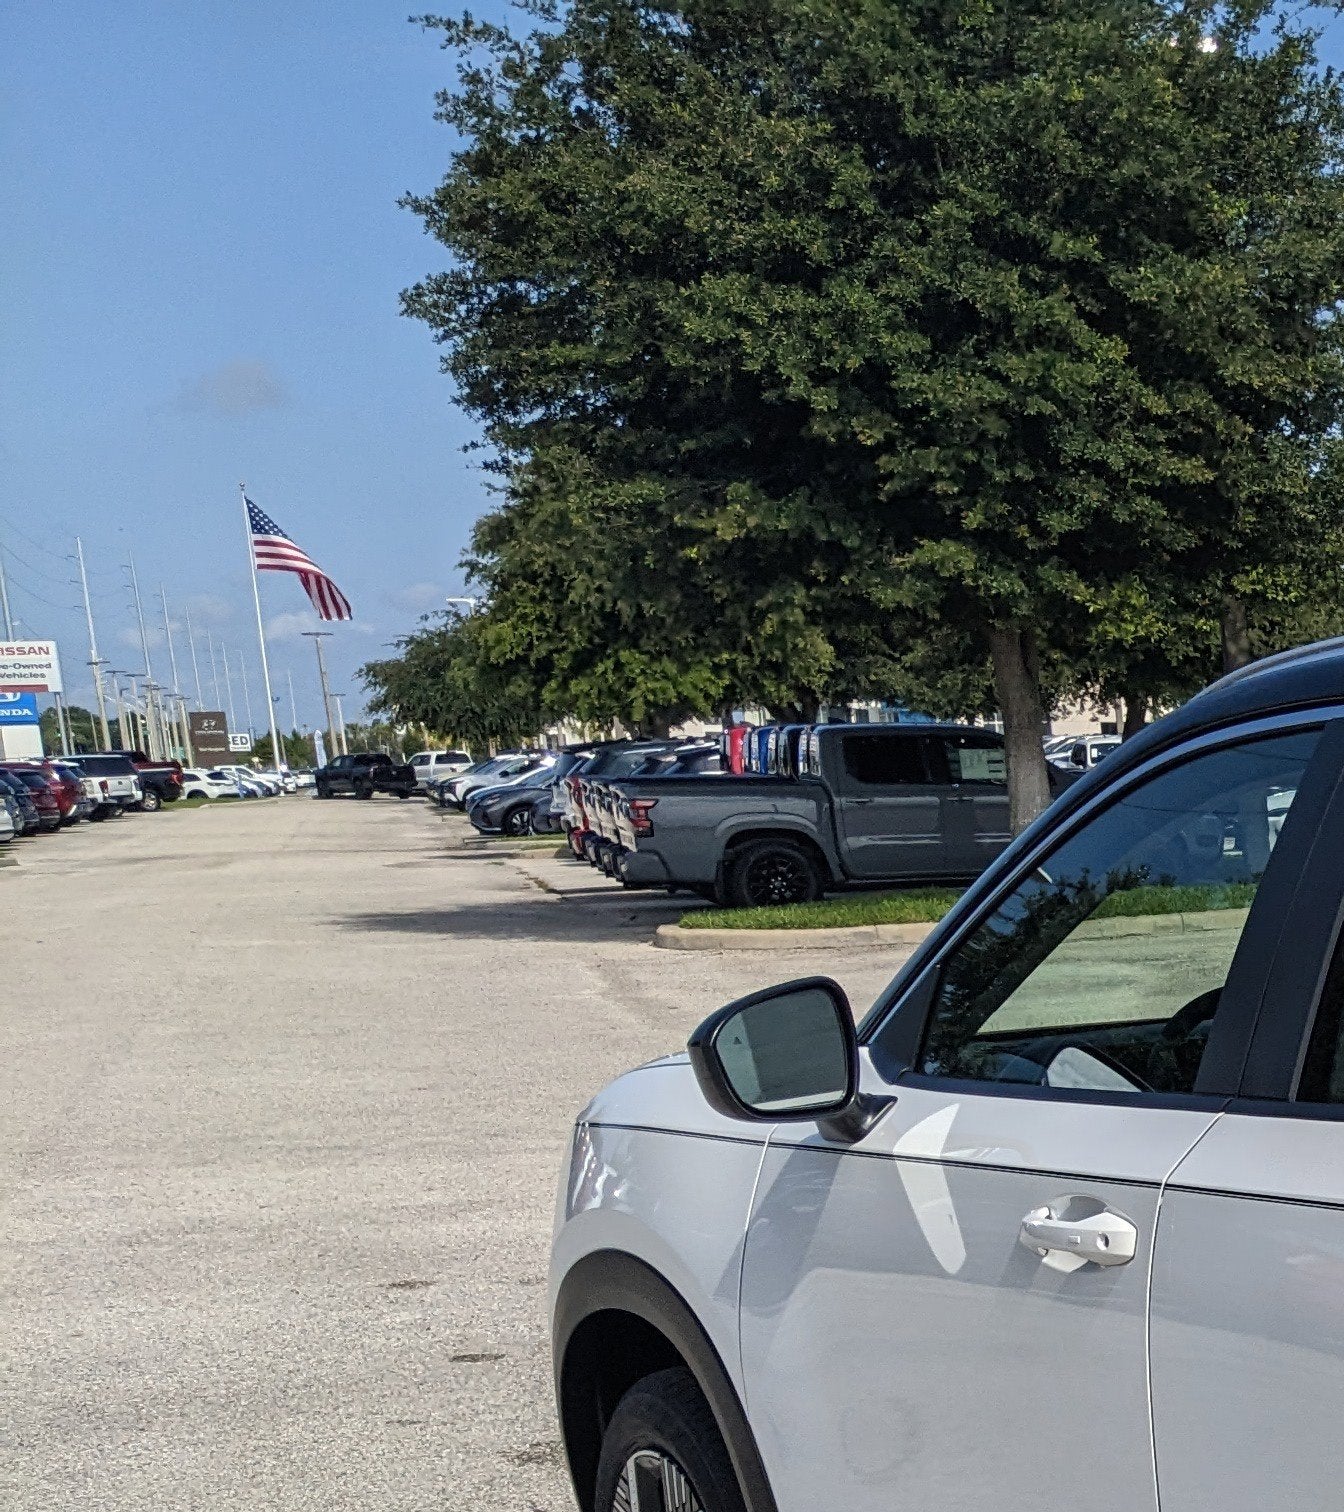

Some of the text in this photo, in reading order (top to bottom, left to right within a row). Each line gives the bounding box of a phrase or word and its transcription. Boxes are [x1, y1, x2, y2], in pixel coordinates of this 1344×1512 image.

[0, 646, 50, 656] ISSAN
[0, 662, 52, 670] e-Owned
[0, 708, 33, 716] NDA
[228, 735, 249, 746] ED
